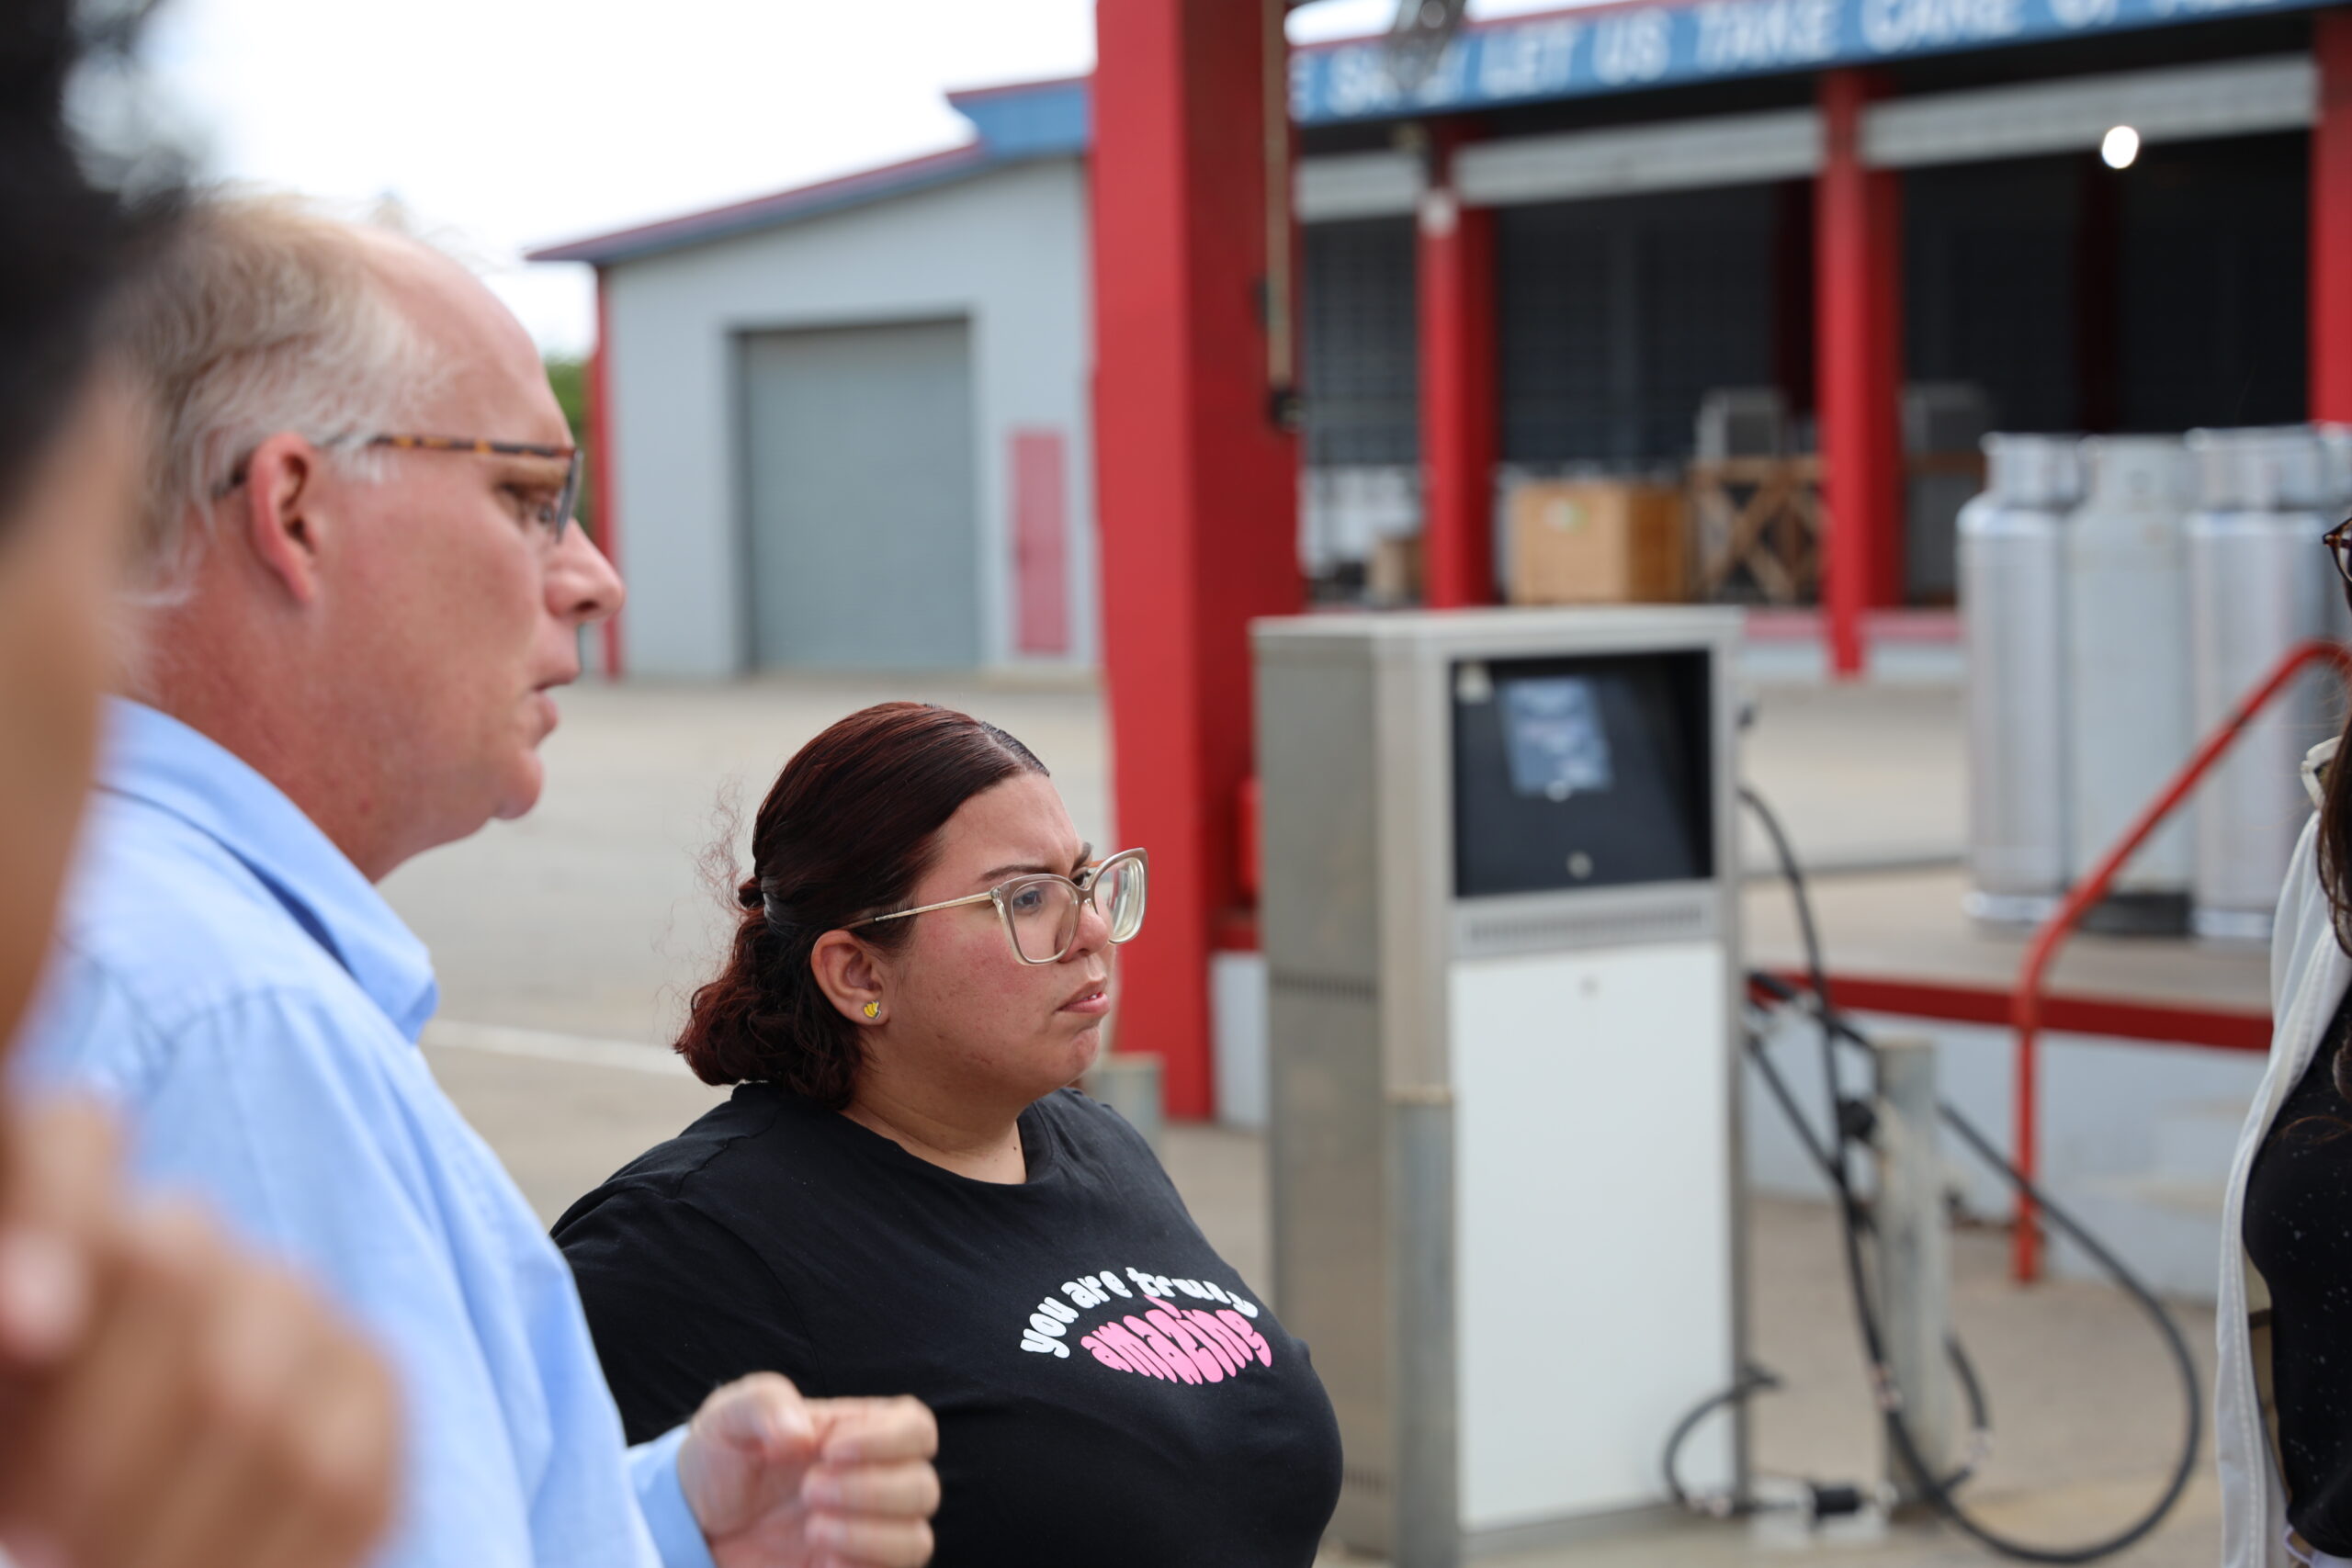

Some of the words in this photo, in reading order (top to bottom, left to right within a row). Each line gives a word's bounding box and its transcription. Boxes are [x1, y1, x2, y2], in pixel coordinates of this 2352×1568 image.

[1479, 20, 1580, 101] LET
[1592, 9, 1673, 86] US
[1020, 1296, 1080, 1359] you
[1060, 1270, 1134, 1310] are
[1125, 1267, 1260, 1319] truly
[1080, 1294, 1272, 1385] amazing
